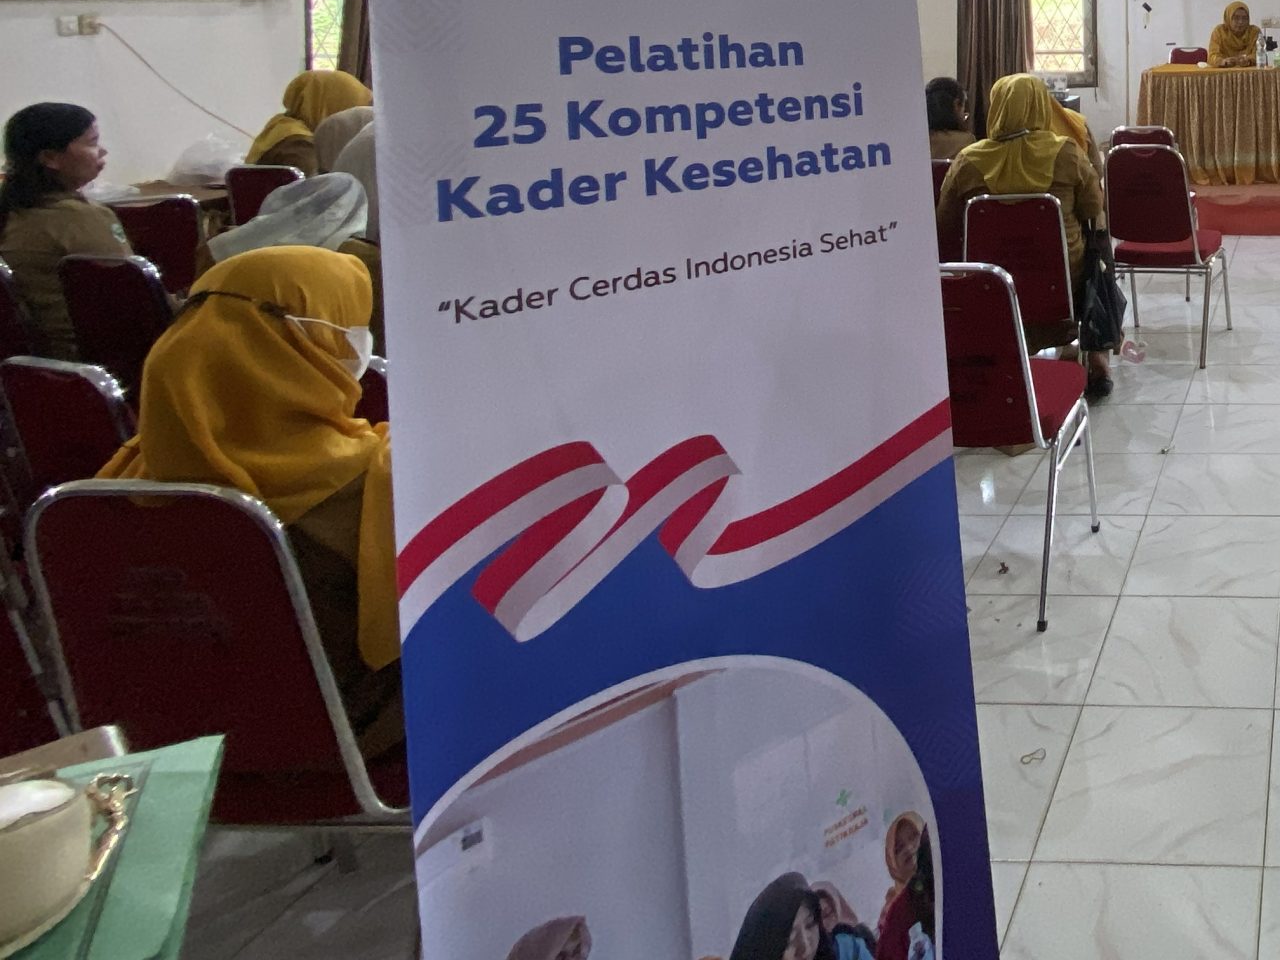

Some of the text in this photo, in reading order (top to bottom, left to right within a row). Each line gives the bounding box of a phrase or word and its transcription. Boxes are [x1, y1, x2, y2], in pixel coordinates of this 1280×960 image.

[558, 32, 804, 75] Pelatihan
[473, 81, 864, 148] 25 Kompetensi
[437, 141, 892, 222] Kader Kesehatan
[438, 221, 899, 324] “Kader Cerdas Indonesia Sehat”
